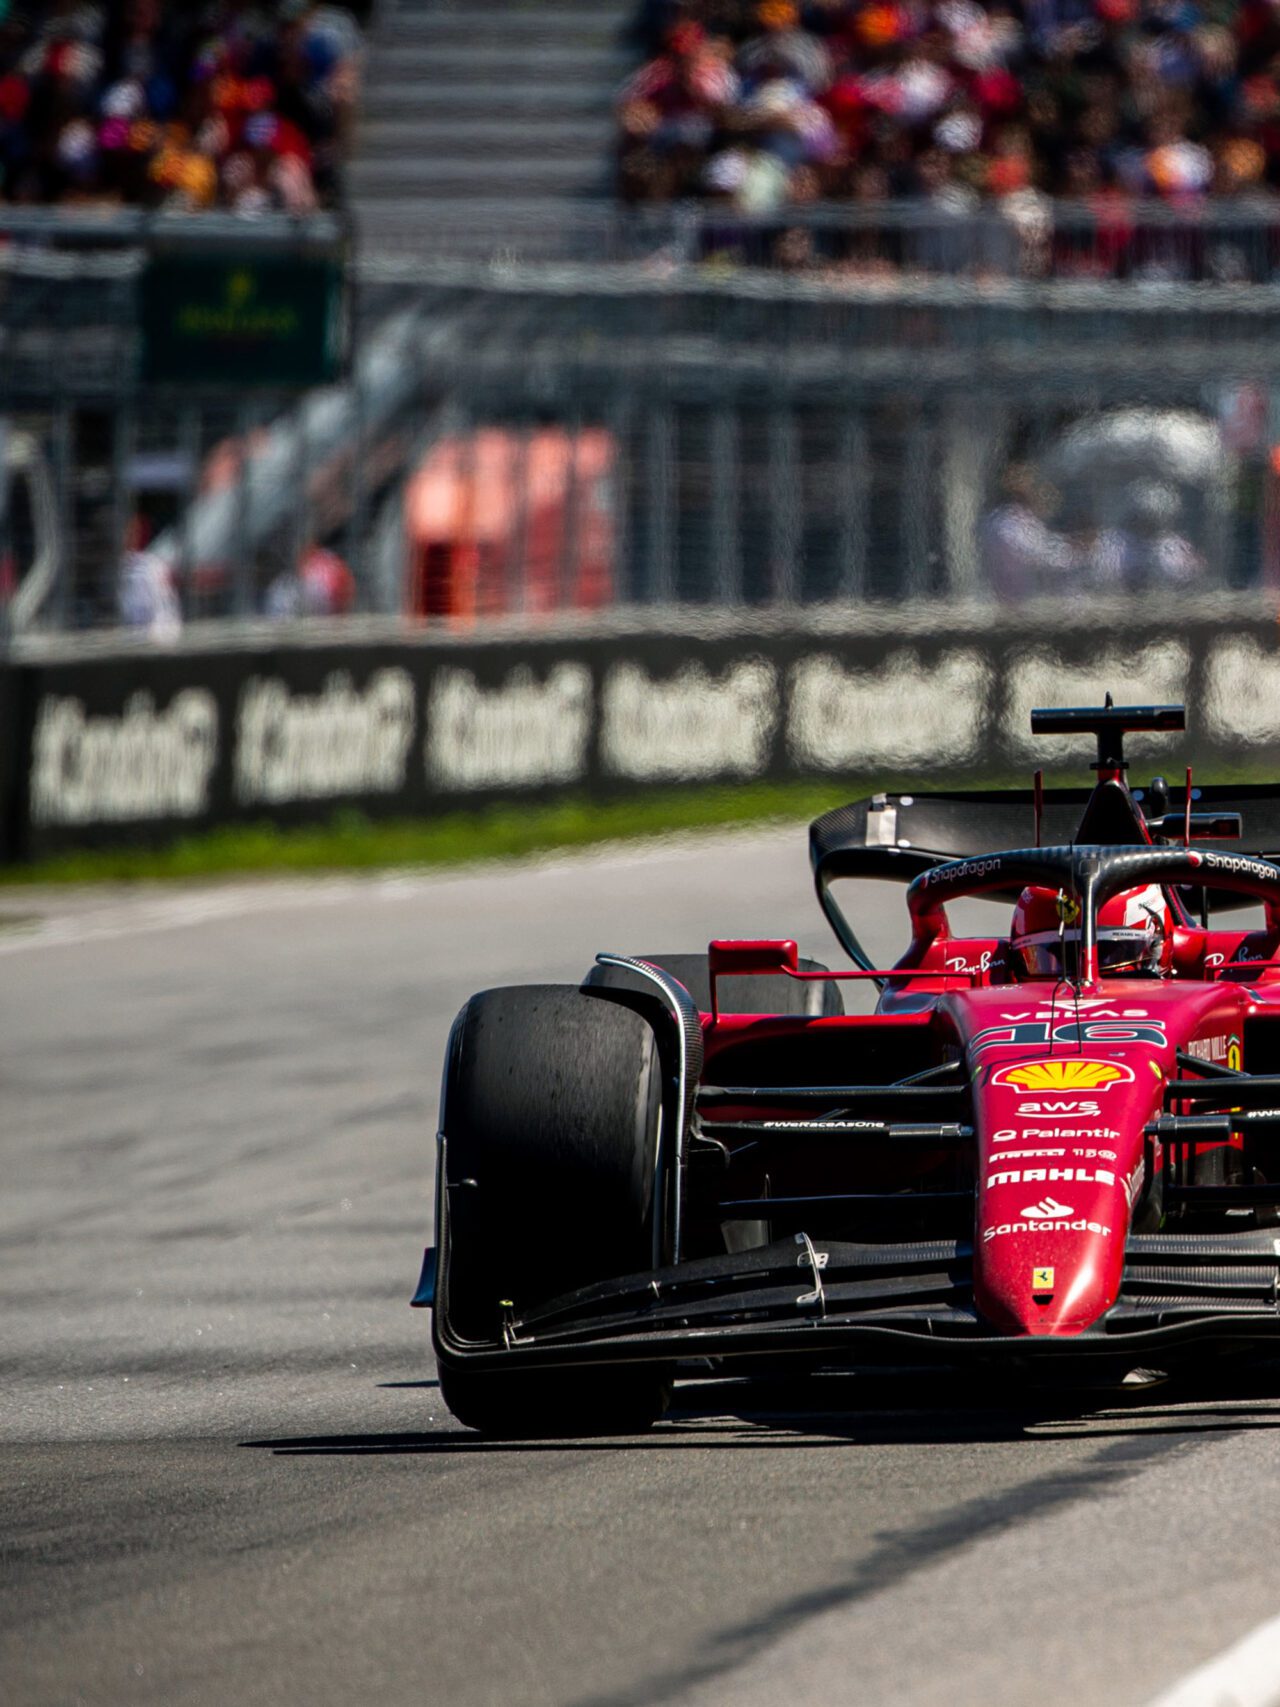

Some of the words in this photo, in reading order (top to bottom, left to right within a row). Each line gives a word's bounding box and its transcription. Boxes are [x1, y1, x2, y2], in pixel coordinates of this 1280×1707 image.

[930, 858, 1001, 884] Snapdragon
[1205, 852, 1278, 880] Snapdragon
[1000, 1009, 1148, 1020] VELAS
[969, 1020, 1168, 1060] 16
[1017, 1101, 1100, 1114] aws
[1022, 1127, 1120, 1139] Palantir
[986, 1168, 1116, 1190] MAHLE
[983, 1219, 1112, 1242] Santander
